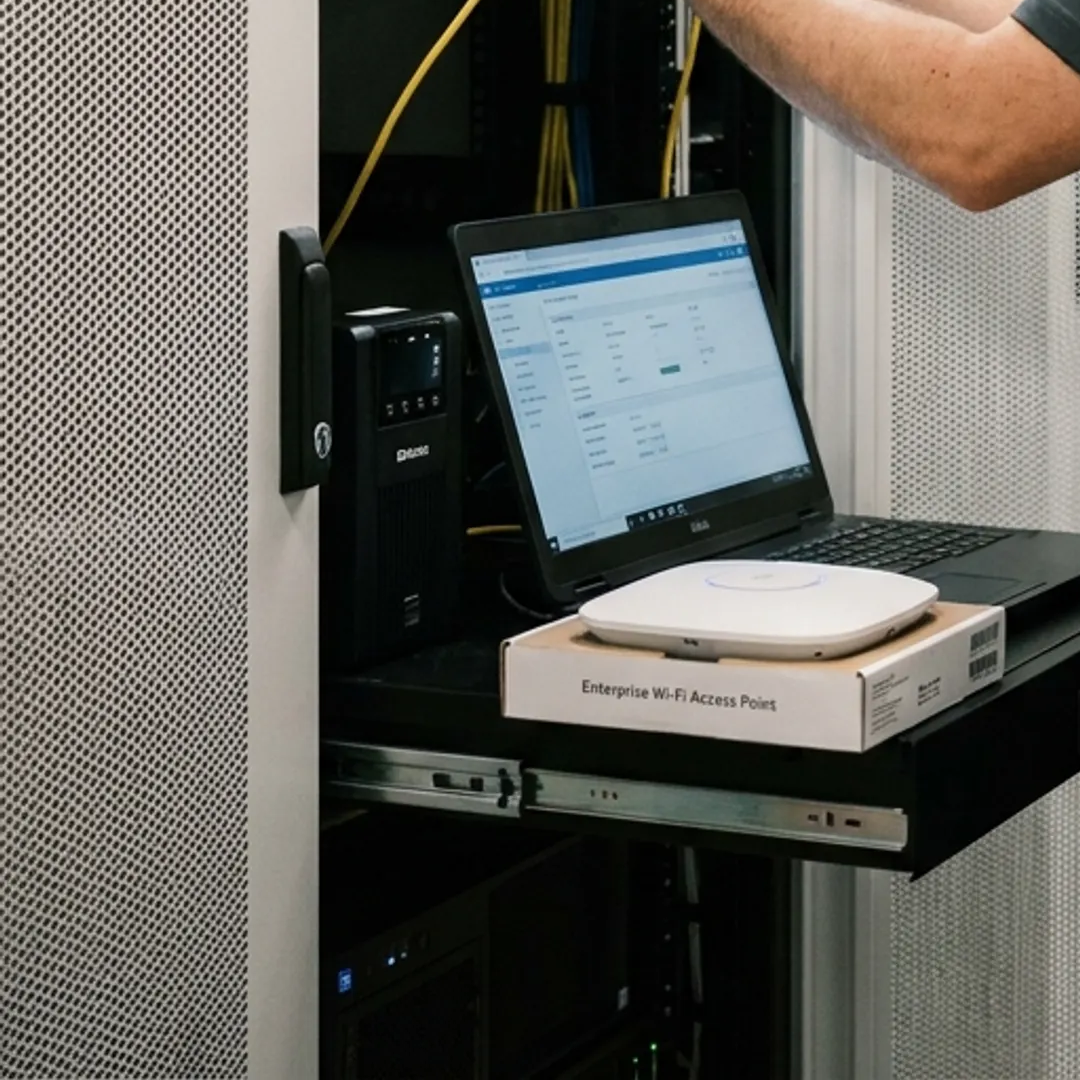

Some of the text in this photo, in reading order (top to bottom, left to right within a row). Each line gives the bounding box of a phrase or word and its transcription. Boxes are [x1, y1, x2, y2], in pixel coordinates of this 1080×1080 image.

[581, 679, 649, 700] Enterprise
[651, 686, 687, 702] Wi-Fi
[689, 689, 737, 708] Access
